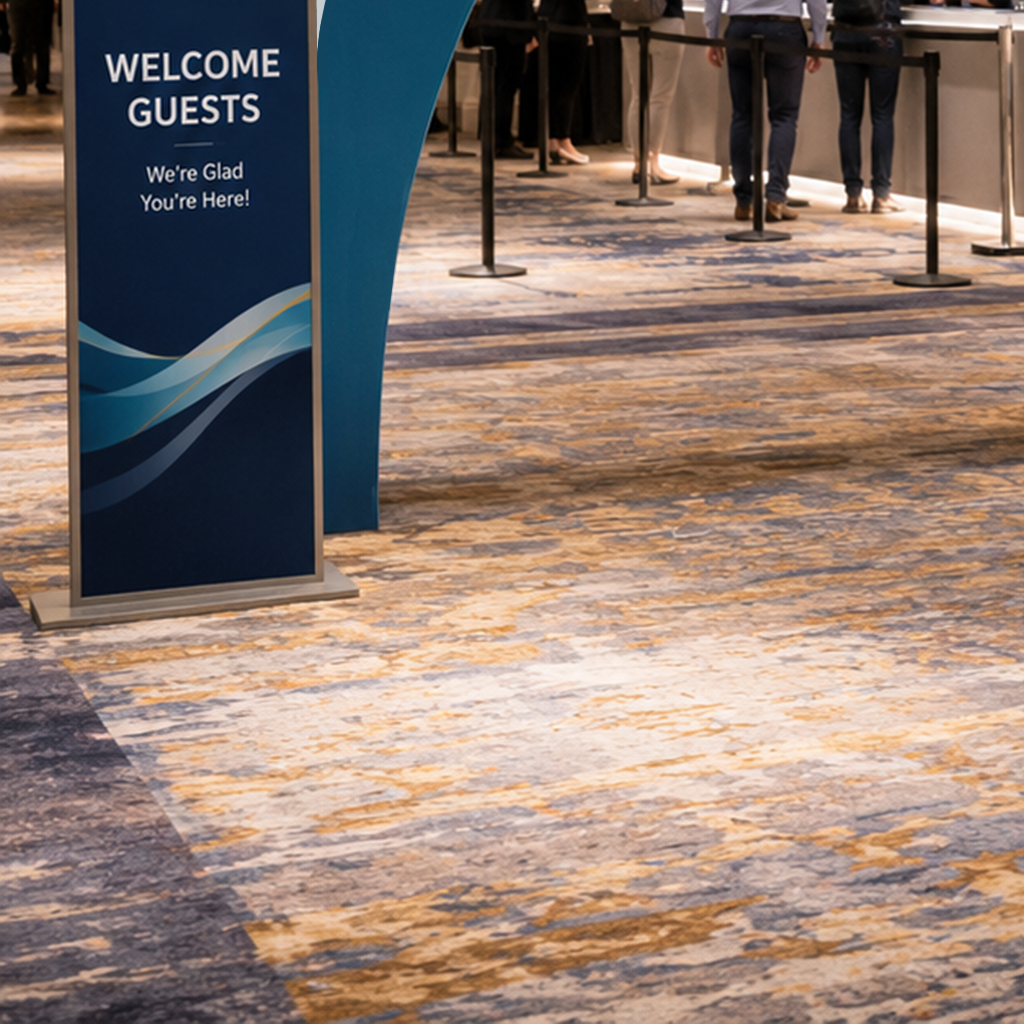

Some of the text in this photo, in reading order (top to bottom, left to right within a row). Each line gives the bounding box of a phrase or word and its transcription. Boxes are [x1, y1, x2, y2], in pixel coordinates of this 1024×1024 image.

[105, 48, 281, 84] WELCOME
[127, 93, 261, 127] GUESTS
[146, 161, 244, 184] We're Glad
[140, 189, 250, 213] You're Here!
